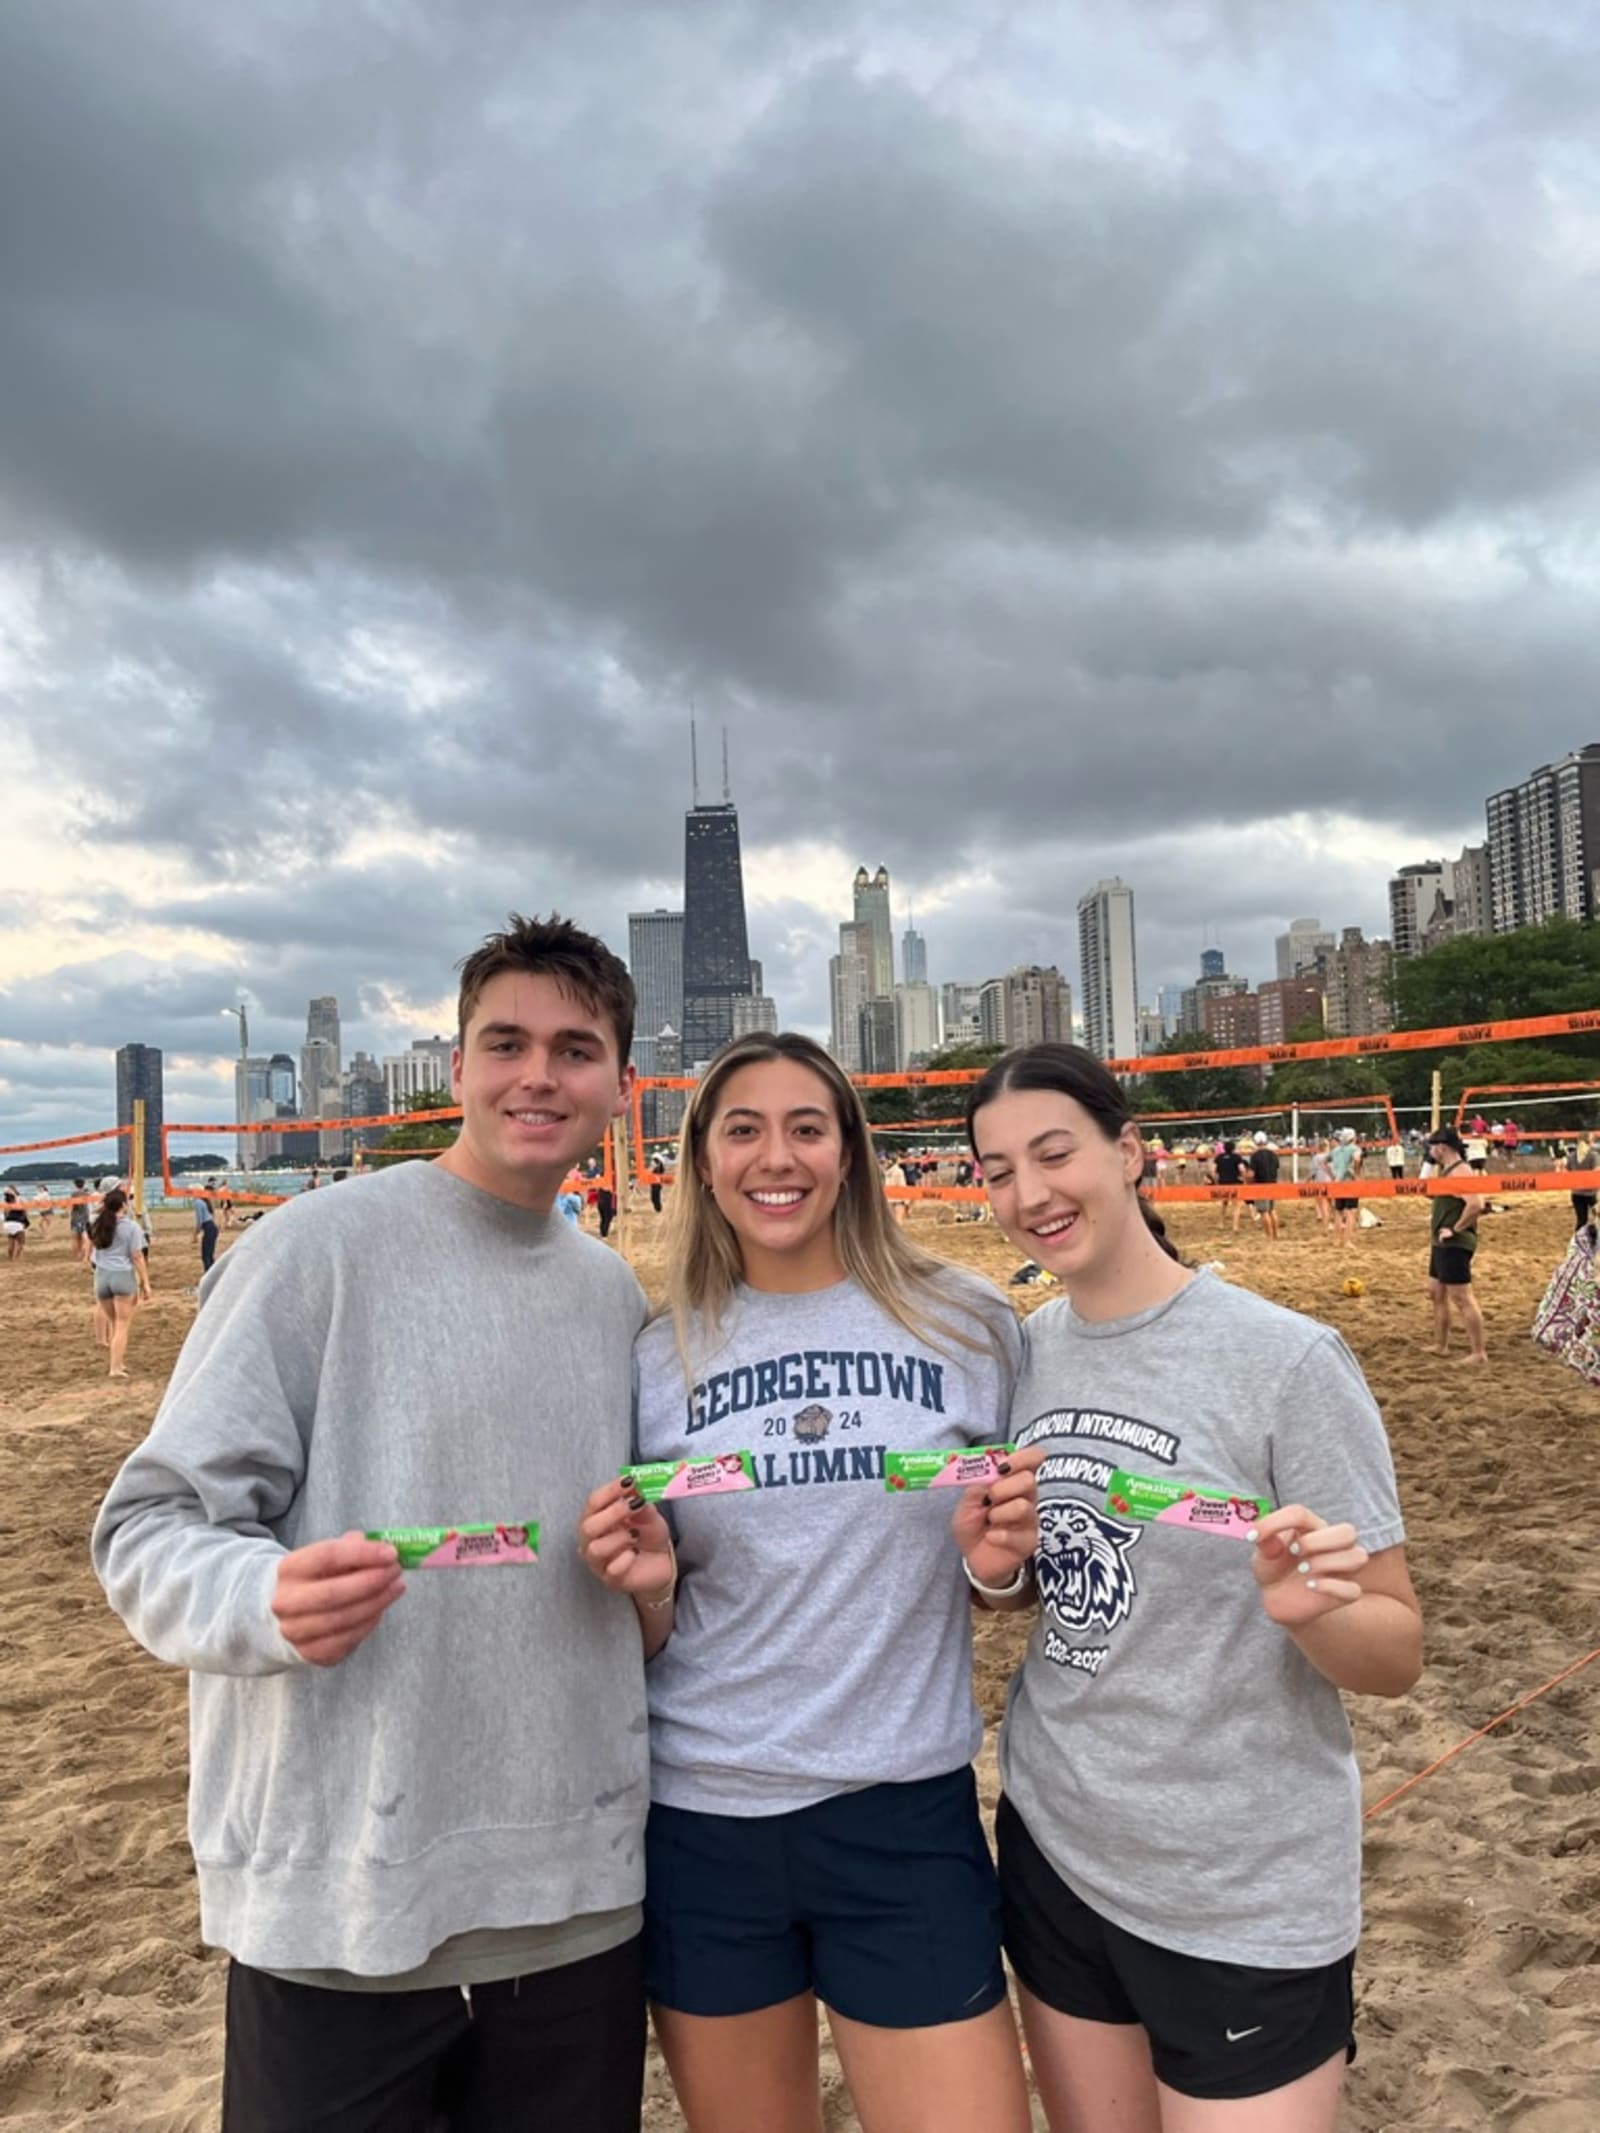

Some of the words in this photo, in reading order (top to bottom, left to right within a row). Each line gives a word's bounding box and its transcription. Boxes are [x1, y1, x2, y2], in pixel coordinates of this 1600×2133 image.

[685, 1351, 945, 1435] GEORGETOWN
[764, 1418, 786, 1436] 20
[839, 1412, 862, 1430] 24
[1074, 1413, 1178, 1461] INTRAMURAL
